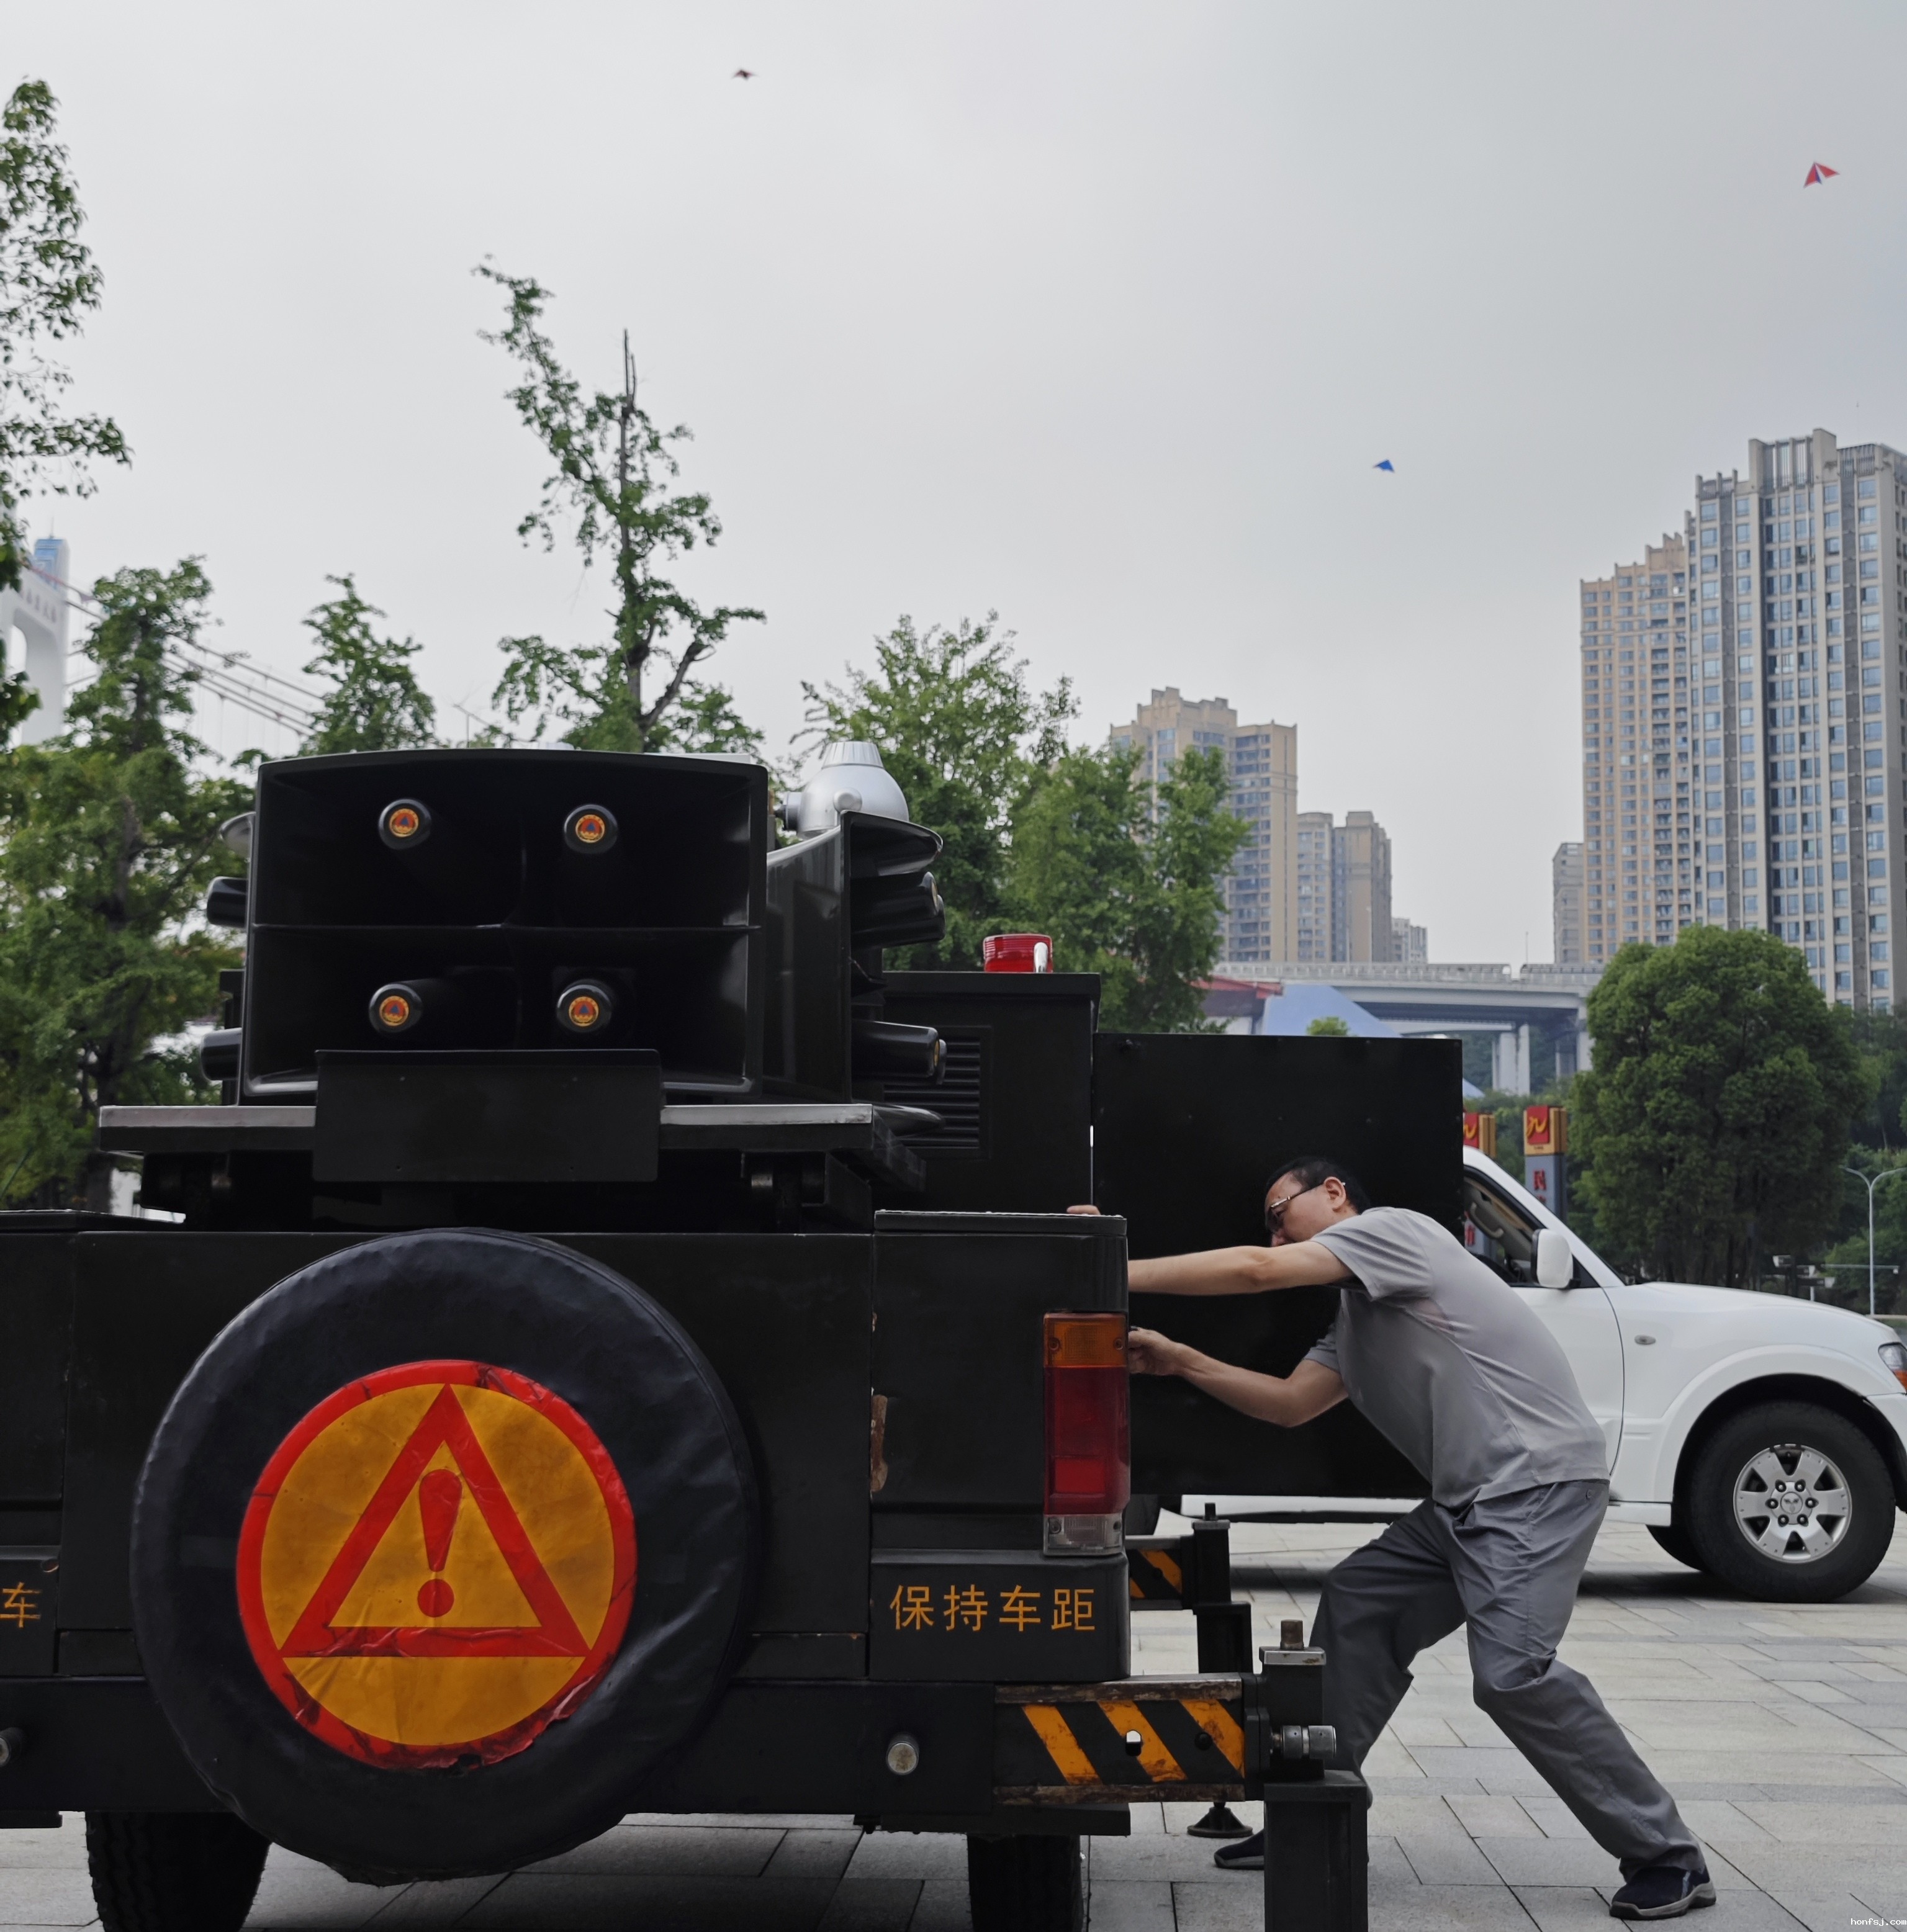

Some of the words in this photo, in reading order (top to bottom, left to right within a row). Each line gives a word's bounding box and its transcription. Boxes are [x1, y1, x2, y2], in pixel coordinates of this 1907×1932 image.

[0, 1582, 42, 1628] 车
[890, 1584, 1095, 1632] 保持车距
